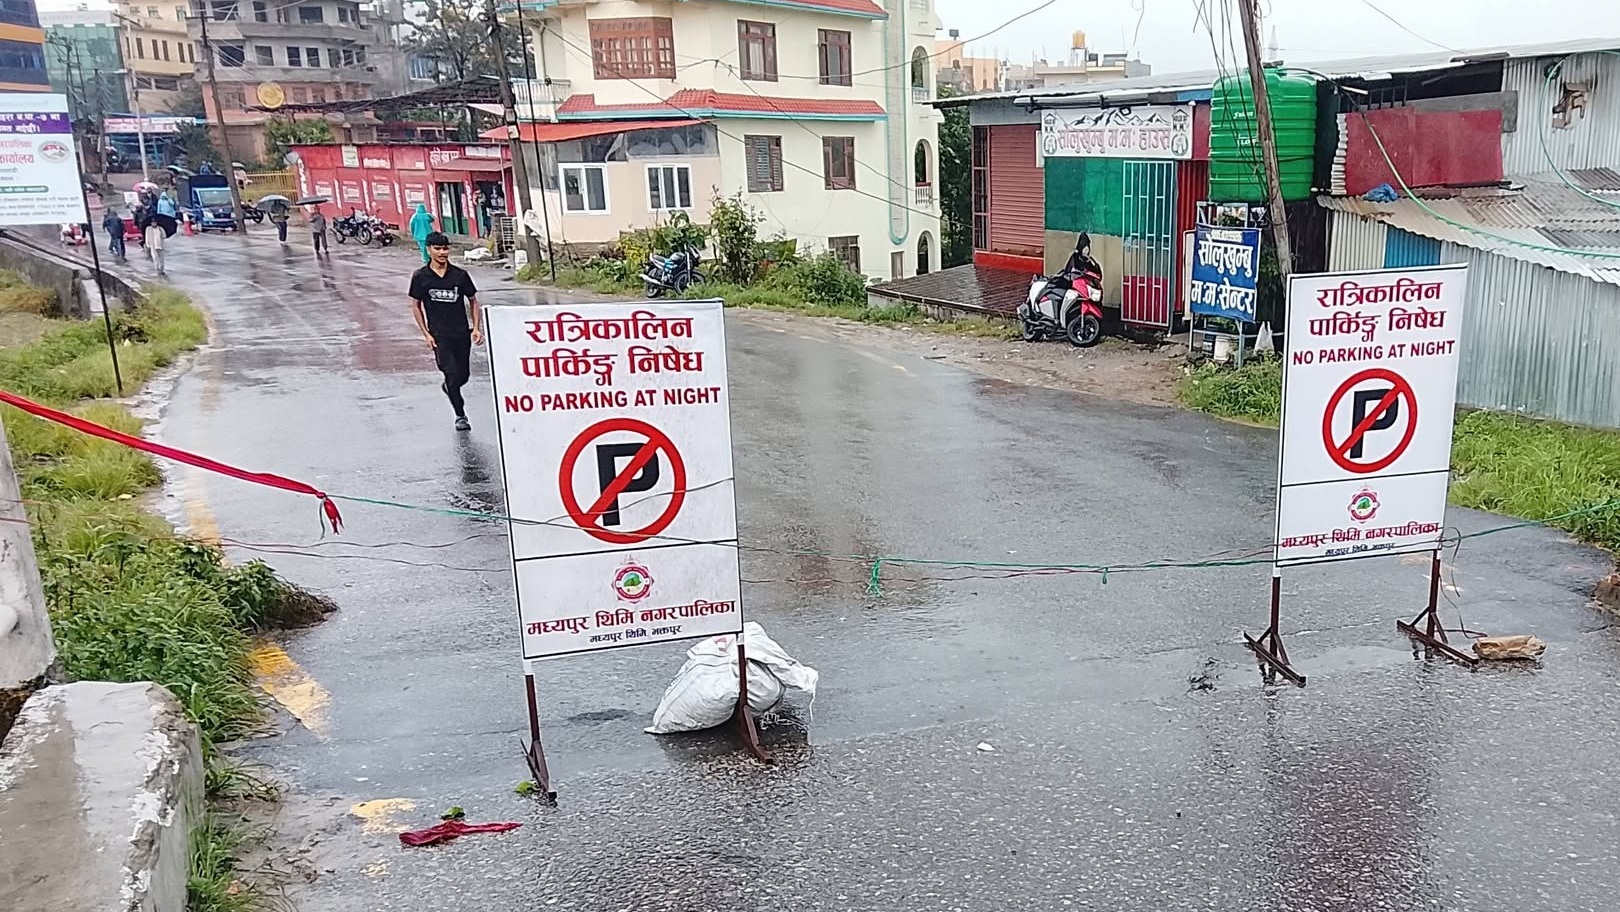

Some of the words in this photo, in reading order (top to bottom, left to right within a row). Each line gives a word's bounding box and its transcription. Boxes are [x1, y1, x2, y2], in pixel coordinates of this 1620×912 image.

[1198, 234, 1254, 278] सोलुखुम्बु
[1317, 278, 1444, 308] रात्रिकालिन
[524, 310, 694, 343] रात्रिकालिन
[1388, 306, 1447, 331] निषेध
[628, 345, 704, 374] निषेध
[1293, 350, 1314, 366] NO
[1318, 345, 1384, 364] PARKING
[1387, 343, 1407, 359] AT
[1410, 340, 1456, 357] NIGHT
[504, 394, 534, 413] NO
[540, 391, 628, 411] PARKING
[633, 389, 657, 407] AT
[663, 387, 721, 406] NIGHT
[527, 616, 590, 635] मध्यपुर
[595, 609, 634, 628] थिमि
[639, 599, 736, 622] नगरपालिका
